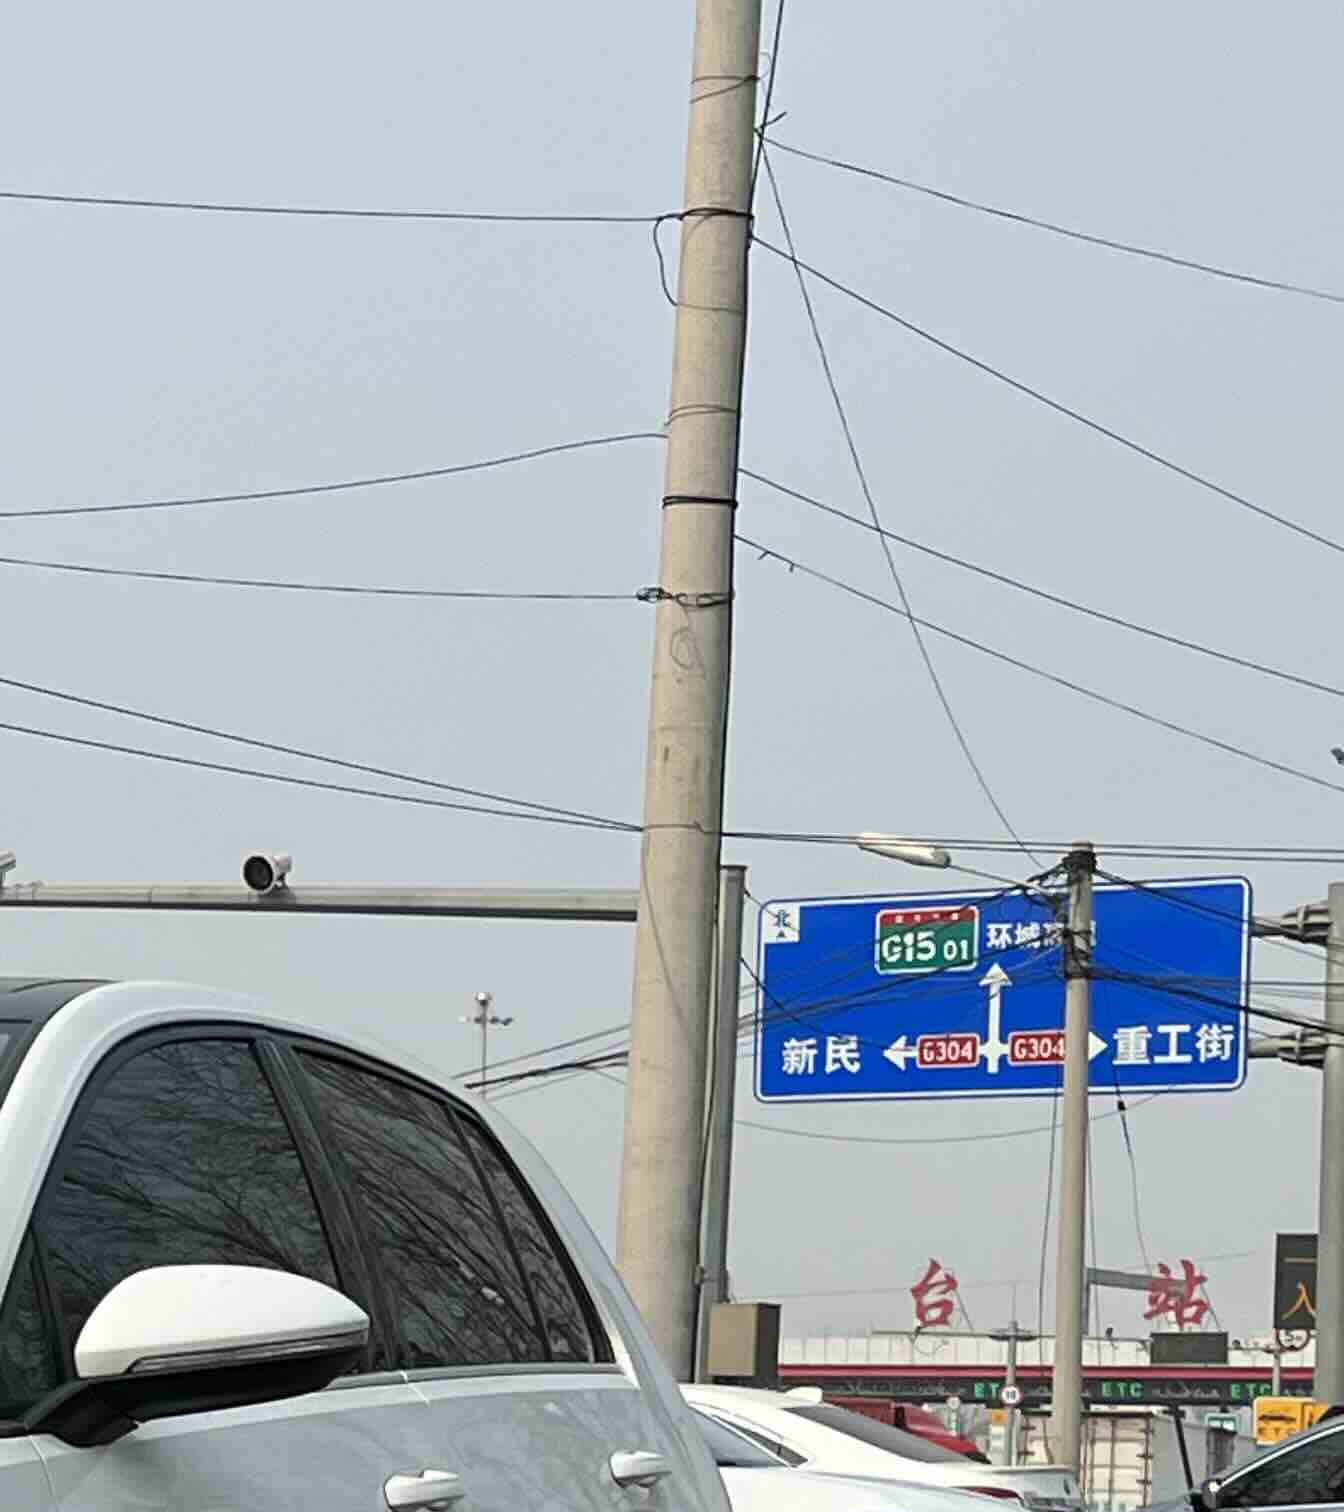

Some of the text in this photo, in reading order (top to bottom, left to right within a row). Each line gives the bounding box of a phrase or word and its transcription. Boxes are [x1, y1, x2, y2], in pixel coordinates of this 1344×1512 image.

[782, 1036, 861, 1074] 新民
[923, 1041, 973, 1063] G304
[1112, 1024, 1235, 1065] 重工街
[1101, 1381, 1144, 1398] ETC
[1230, 1380, 1273, 1399] ETC
